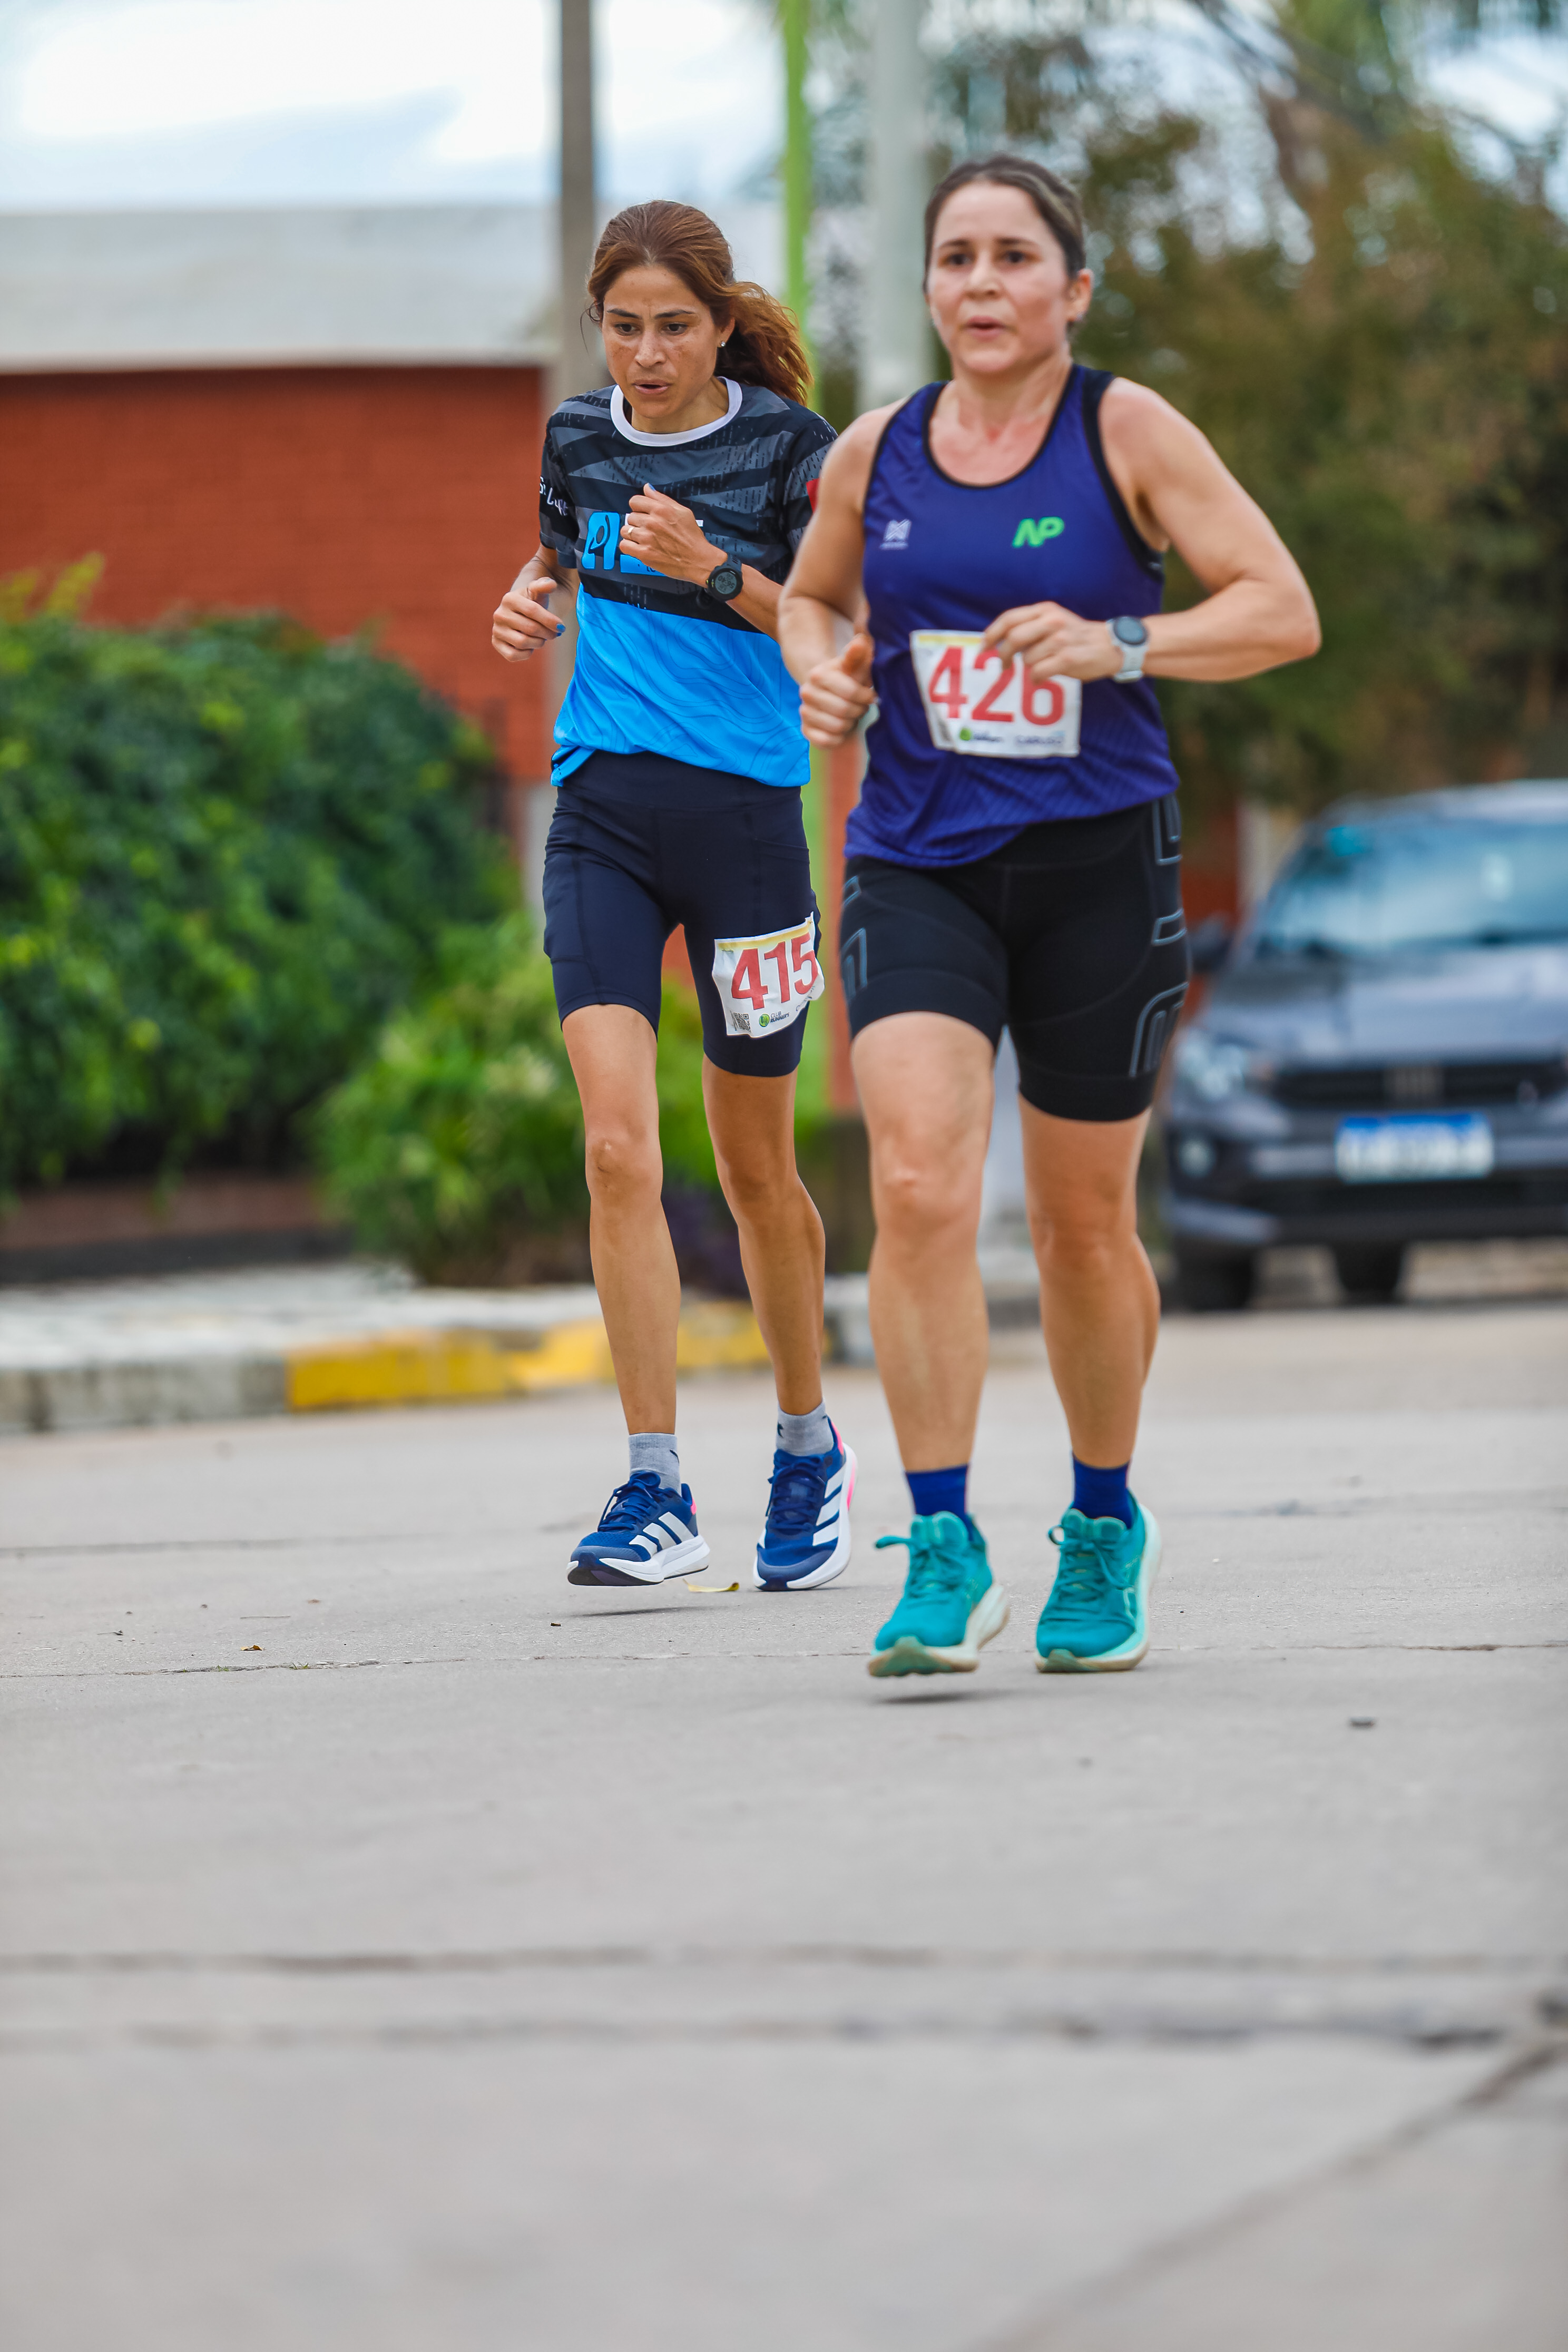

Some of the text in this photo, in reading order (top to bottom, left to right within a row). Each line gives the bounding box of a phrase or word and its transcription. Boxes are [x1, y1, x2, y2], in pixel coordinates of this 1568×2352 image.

[1012, 516, 1064, 547] NP
[928, 646, 1064, 726] 426
[731, 932, 819, 1010] 415
